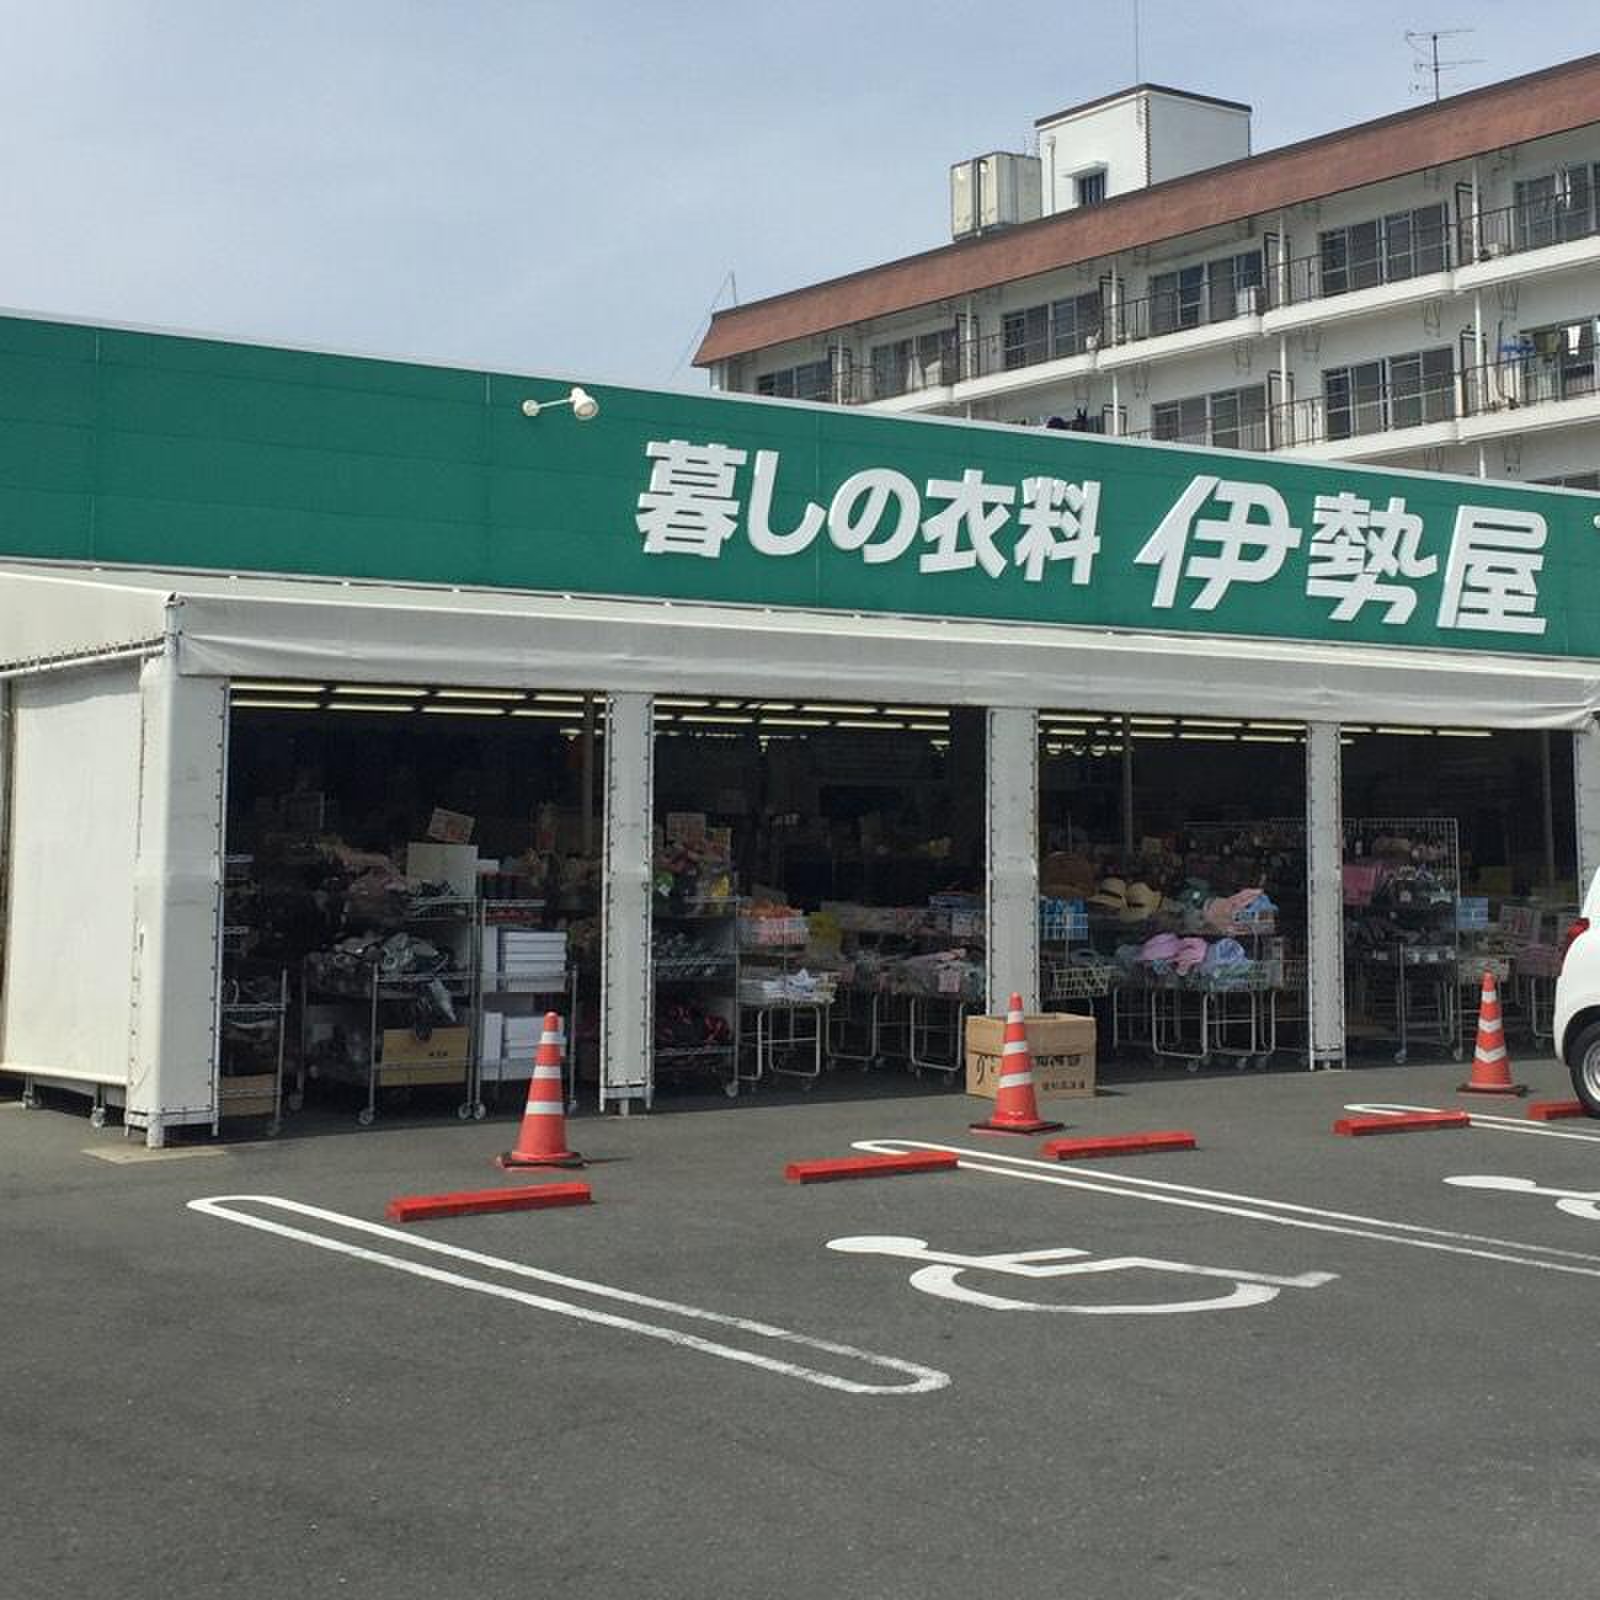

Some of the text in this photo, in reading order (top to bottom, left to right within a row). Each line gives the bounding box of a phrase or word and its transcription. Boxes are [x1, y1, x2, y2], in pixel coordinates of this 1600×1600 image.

[636, 440, 1548, 635] 暮しの衣料 伊勢屋
